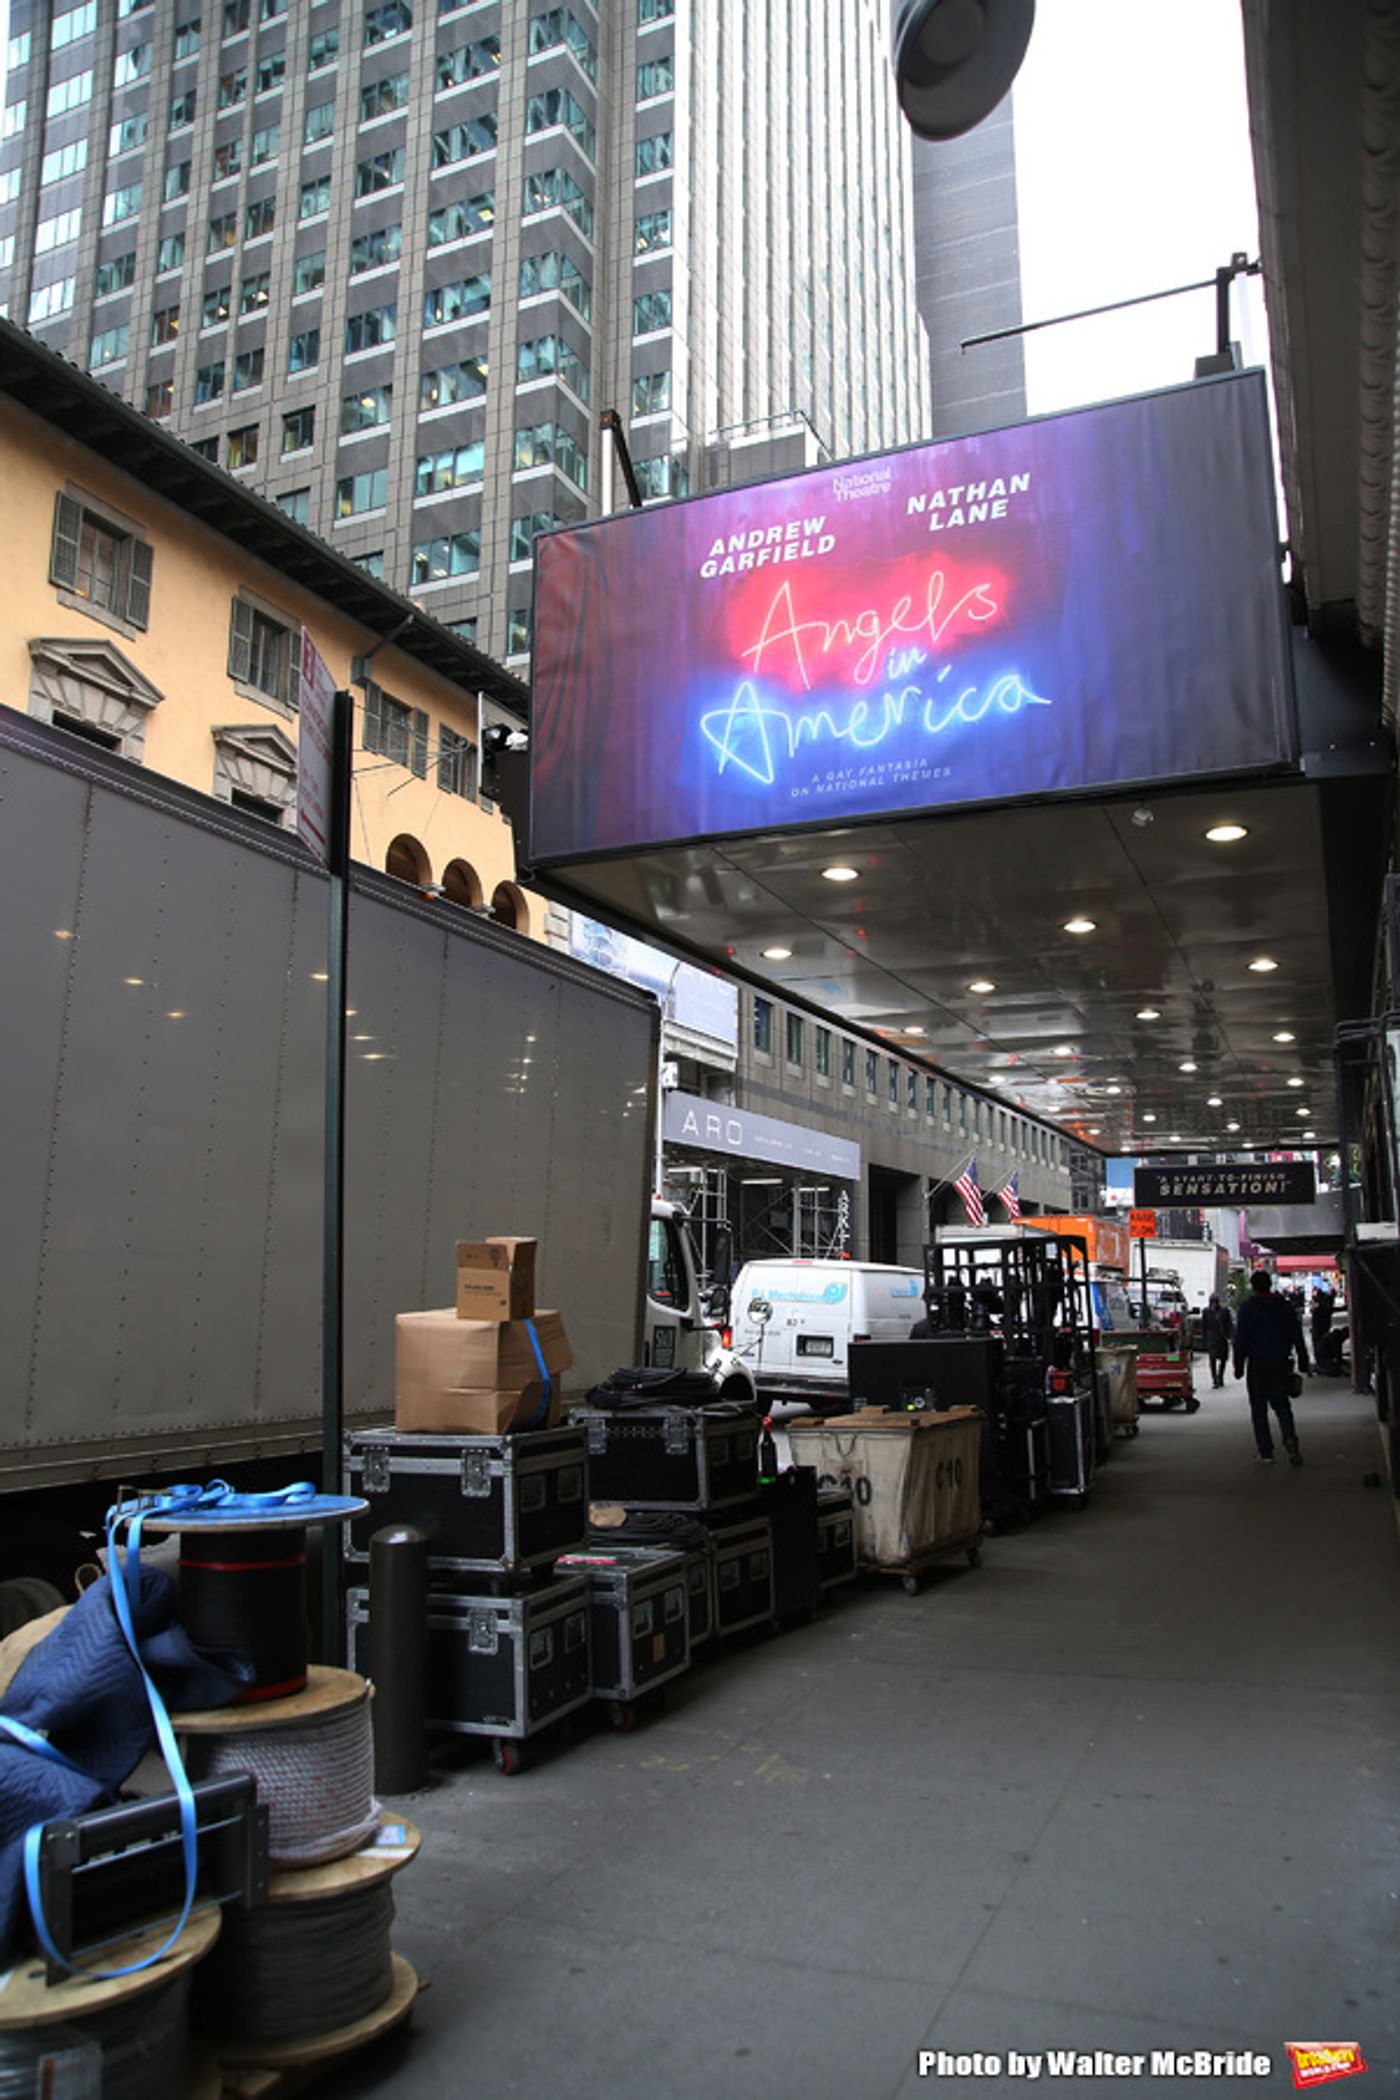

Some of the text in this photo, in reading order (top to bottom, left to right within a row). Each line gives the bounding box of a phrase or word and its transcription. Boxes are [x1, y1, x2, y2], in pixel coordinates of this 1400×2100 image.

[833, 467, 892, 494] National
[835, 481, 892, 502] Theatre
[907, 473, 1031, 515] NATHAN
[928, 499, 1009, 532] LANE
[709, 516, 827, 557] ANDREW
[699, 533, 837, 579] GARFIELD
[742, 571, 998, 690] Angels
[887, 645, 928, 680] in
[701, 663, 1052, 784] America
[791, 767, 952, 798] ON NATIONAL THEMES
[812, 759, 929, 784] A GAY FANTASIA
[680, 1109, 744, 1146] ARO
